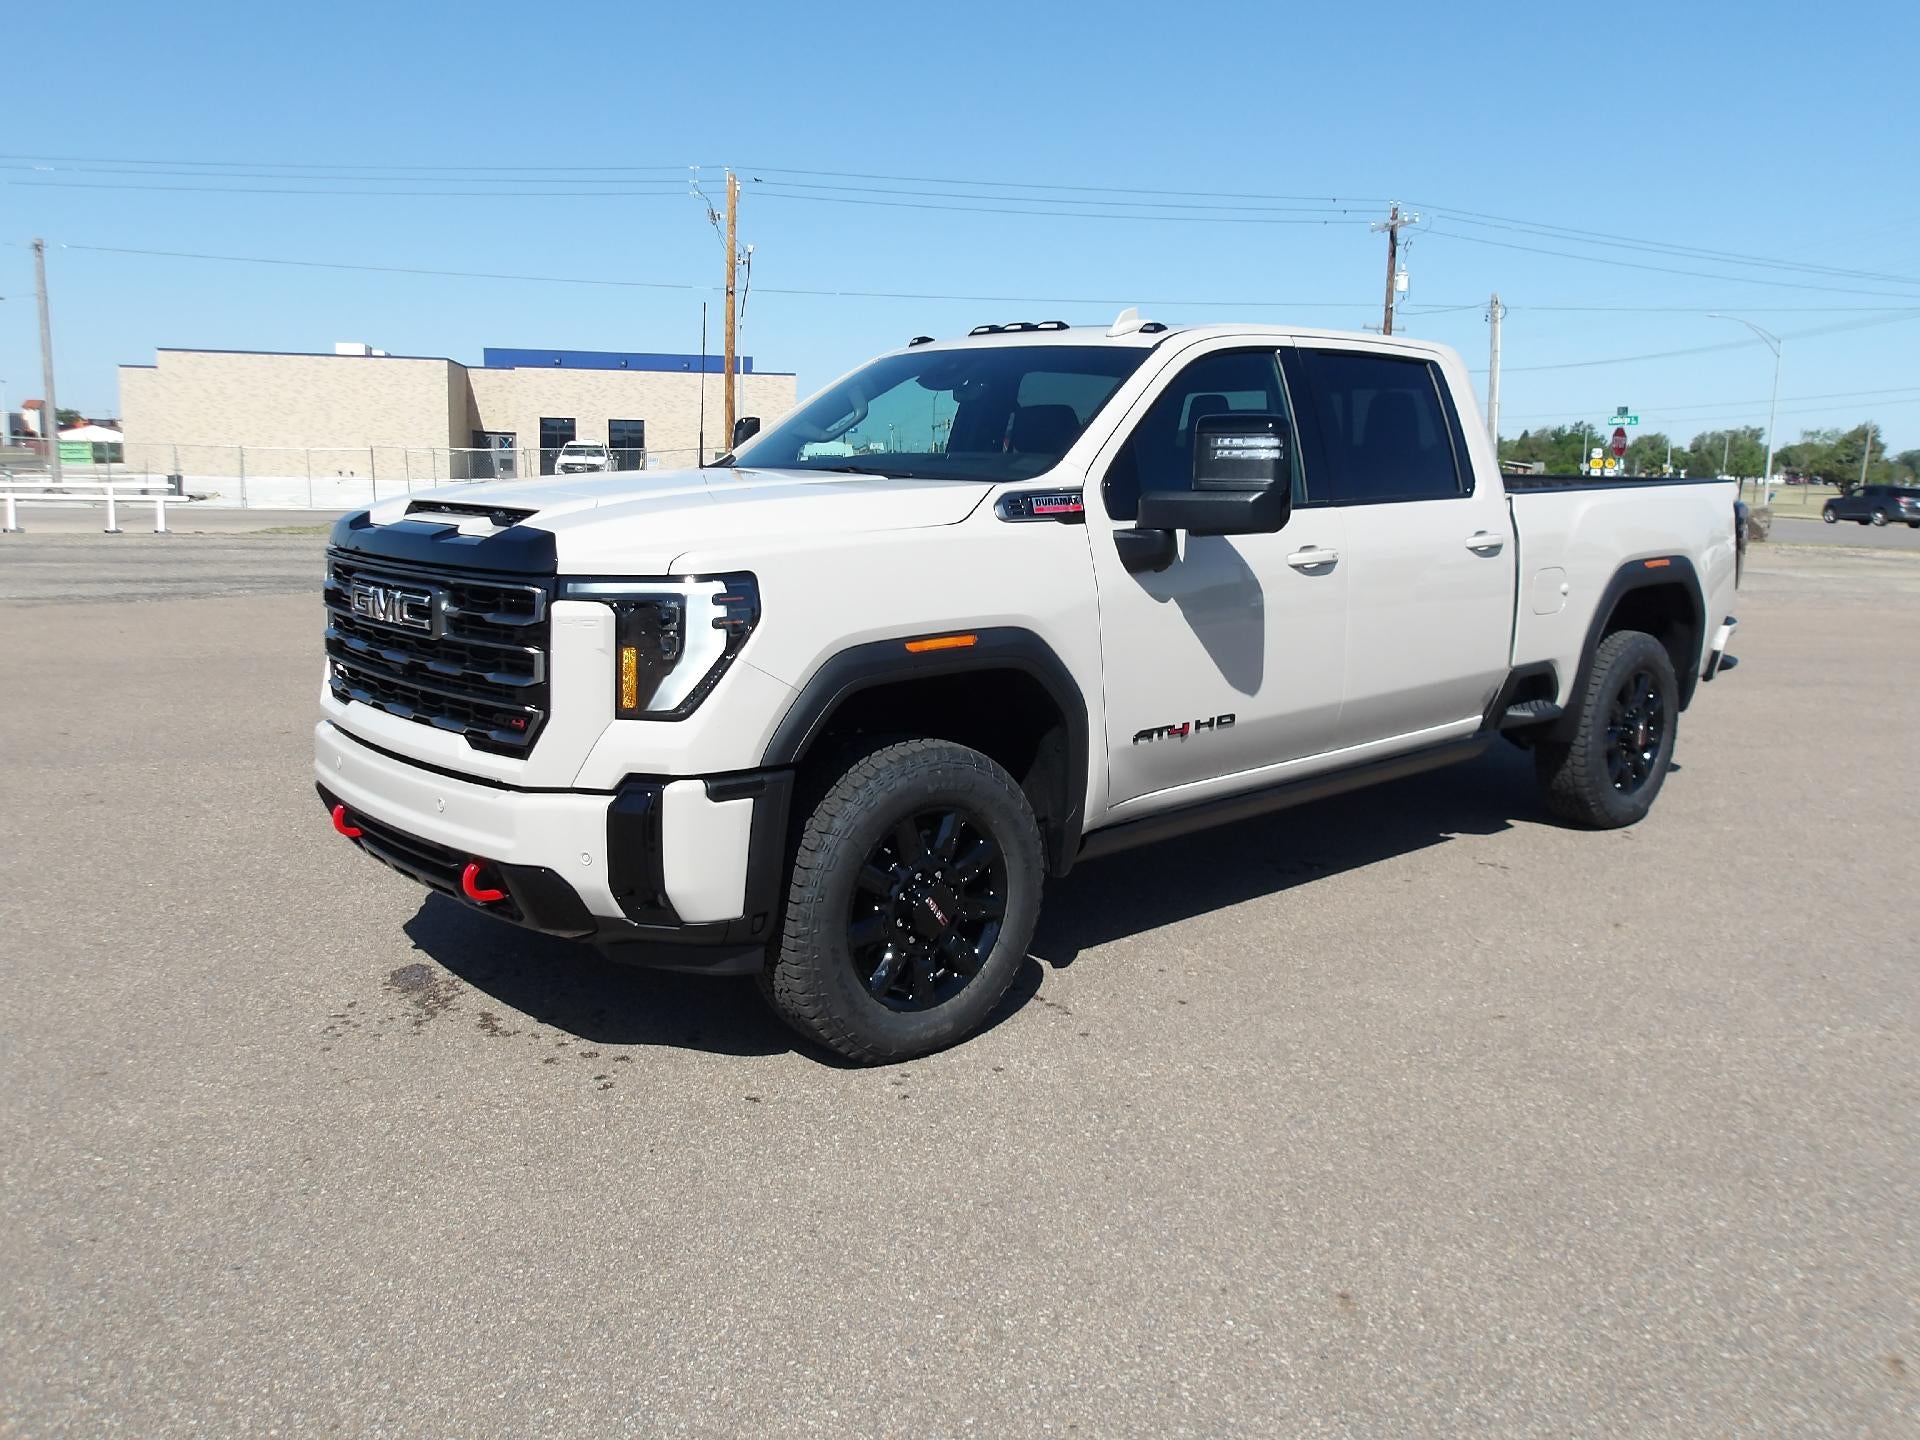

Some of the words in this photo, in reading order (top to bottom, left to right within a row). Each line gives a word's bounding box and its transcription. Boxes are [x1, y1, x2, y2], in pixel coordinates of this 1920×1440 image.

[1034, 496, 1079, 507] DURAMAX
[351, 583, 431, 630] GMC
[1132, 722, 1190, 745] AT4
[1194, 713, 1236, 733] HD
